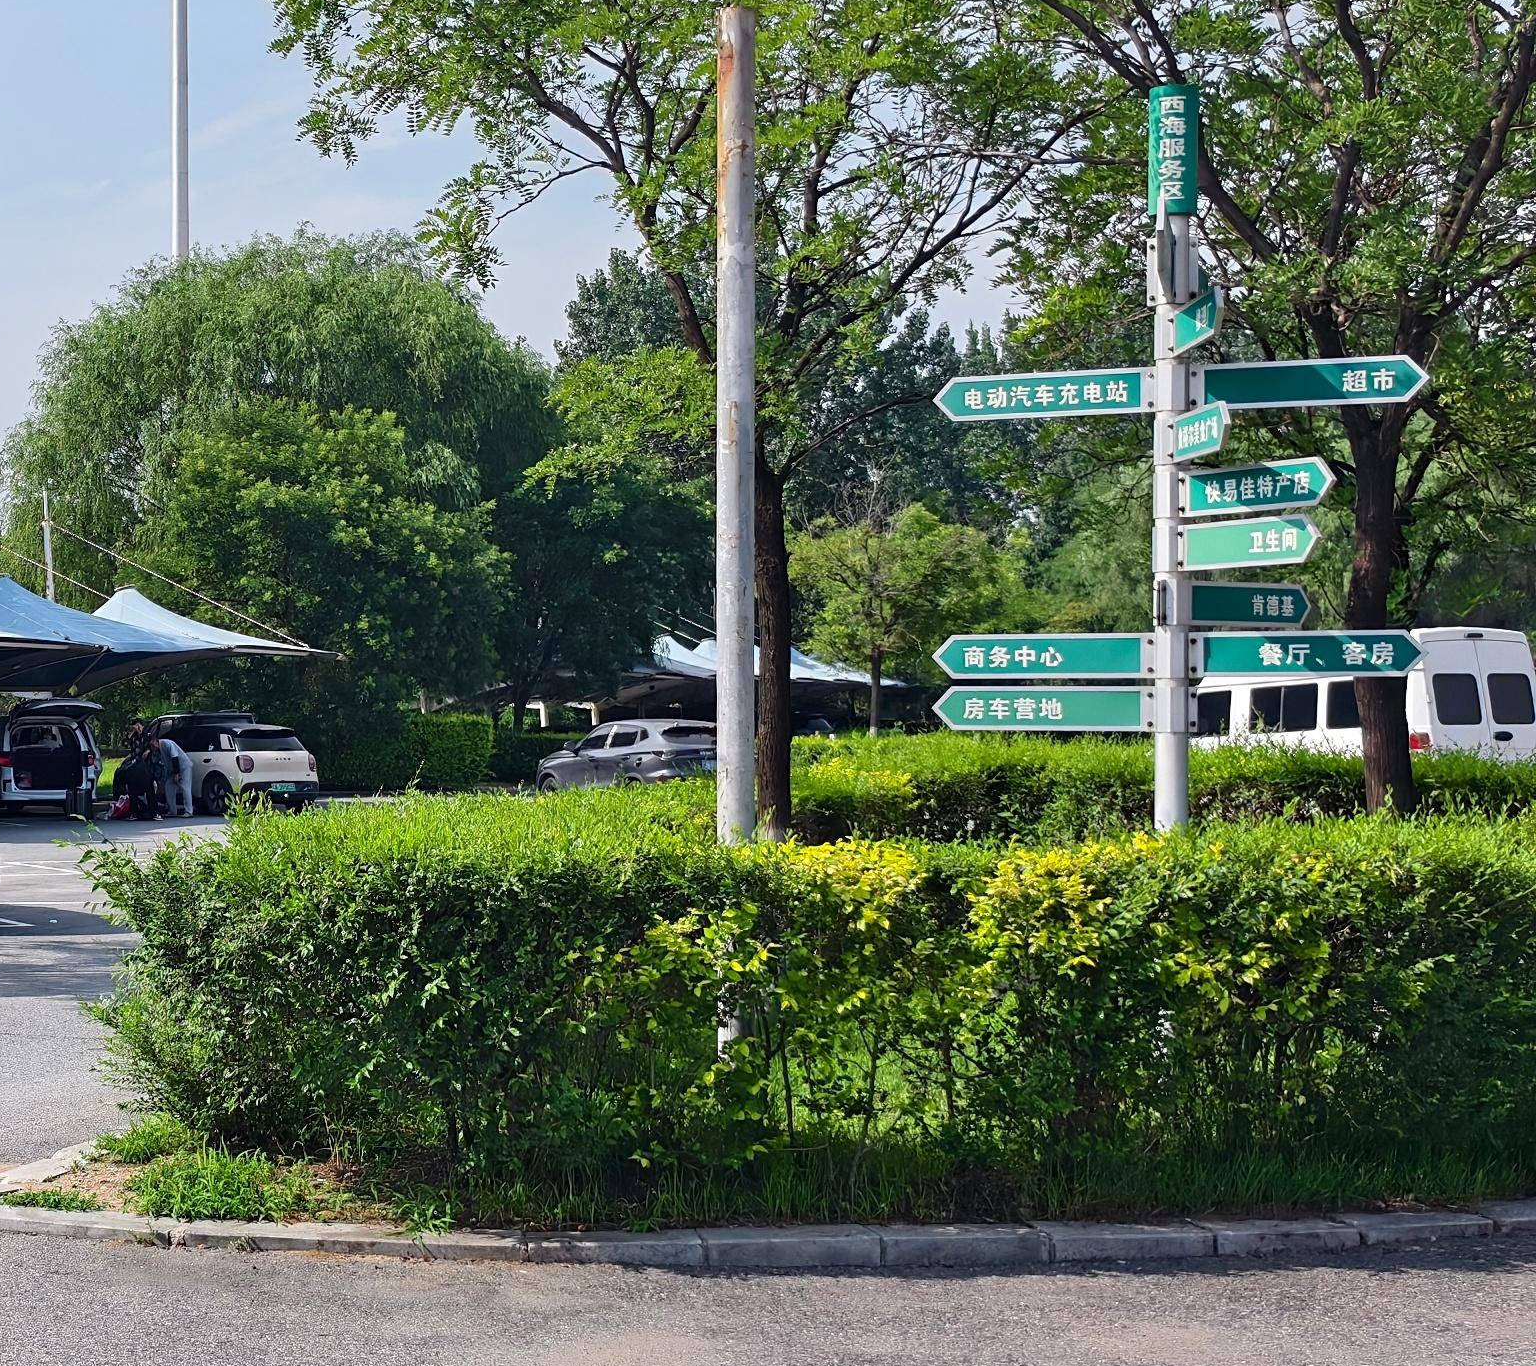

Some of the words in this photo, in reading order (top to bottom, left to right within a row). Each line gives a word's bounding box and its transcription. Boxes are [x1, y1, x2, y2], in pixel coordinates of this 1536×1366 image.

[1158, 95, 1187, 200] 西海服务区
[1341, 368, 1396, 393] 超市
[963, 380, 1129, 410] 电动汽车充电站
[1204, 470, 1310, 504] 快易佳特产店
[1248, 527, 1297, 553] 卫生间
[1251, 593, 1295, 617] 肯德基
[962, 645, 1064, 668] 商务中心
[962, 697, 1064, 720] 房车营地
